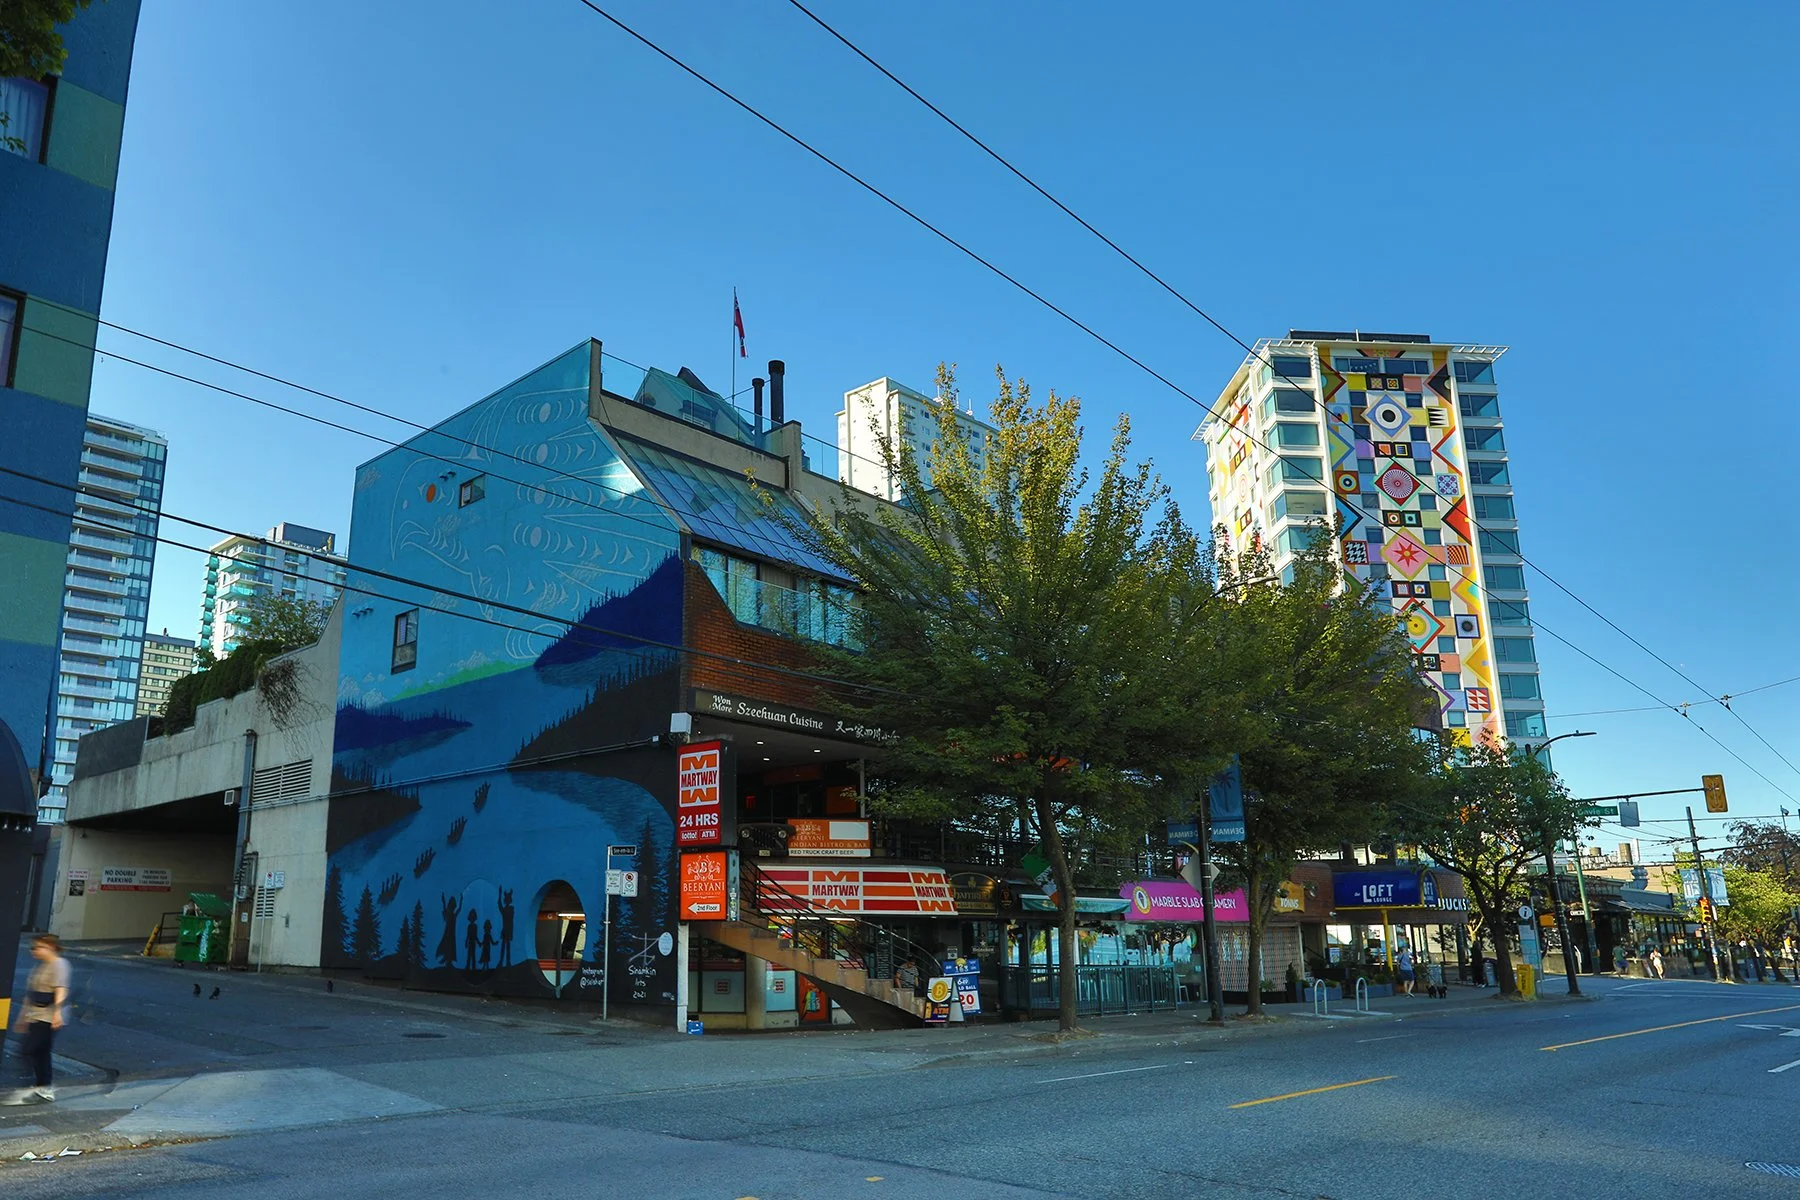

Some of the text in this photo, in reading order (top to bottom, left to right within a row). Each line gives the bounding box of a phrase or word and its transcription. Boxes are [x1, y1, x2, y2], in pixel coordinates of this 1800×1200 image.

[713, 694, 731, 706] Won
[712, 702, 732, 714] More
[737, 702, 823, 730] Szechuan Cuisine
[681, 770, 717, 787] MARTWAY
[1604, 807, 1615, 815] St
[680, 813, 719, 828] 24 HRS
[701, 830, 715, 839] ATM
[683, 882, 725, 892] BEERYANI
[812, 884, 860, 897] MARTWAY
[916, 885, 947, 898] MARTWAY
[1362, 884, 1394, 903] LOFT
[1151, 896, 1182, 908] MARBLE
[1181, 897, 1200, 908] SLAB
[632, 990, 646, 999] 2021
